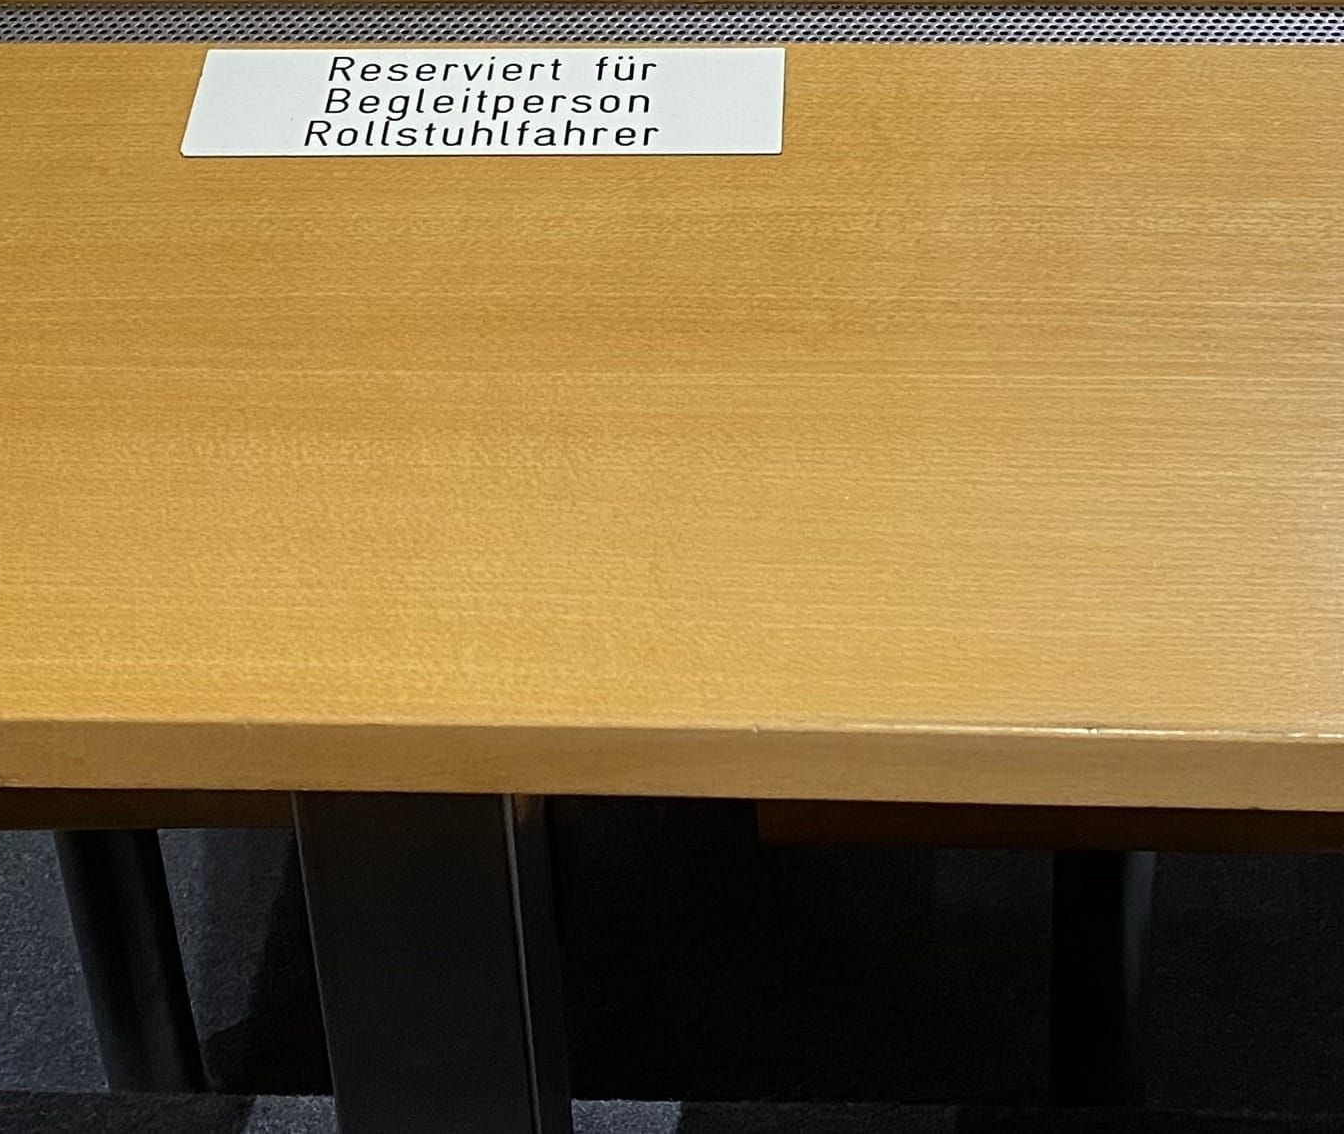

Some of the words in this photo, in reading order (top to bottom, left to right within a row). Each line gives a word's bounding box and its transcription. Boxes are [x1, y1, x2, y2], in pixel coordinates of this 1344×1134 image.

[327, 55, 564, 82] Reserviert
[594, 55, 659, 82] für
[323, 87, 651, 122] Begleitperson
[303, 118, 661, 148] Rollstuhlfahrer
